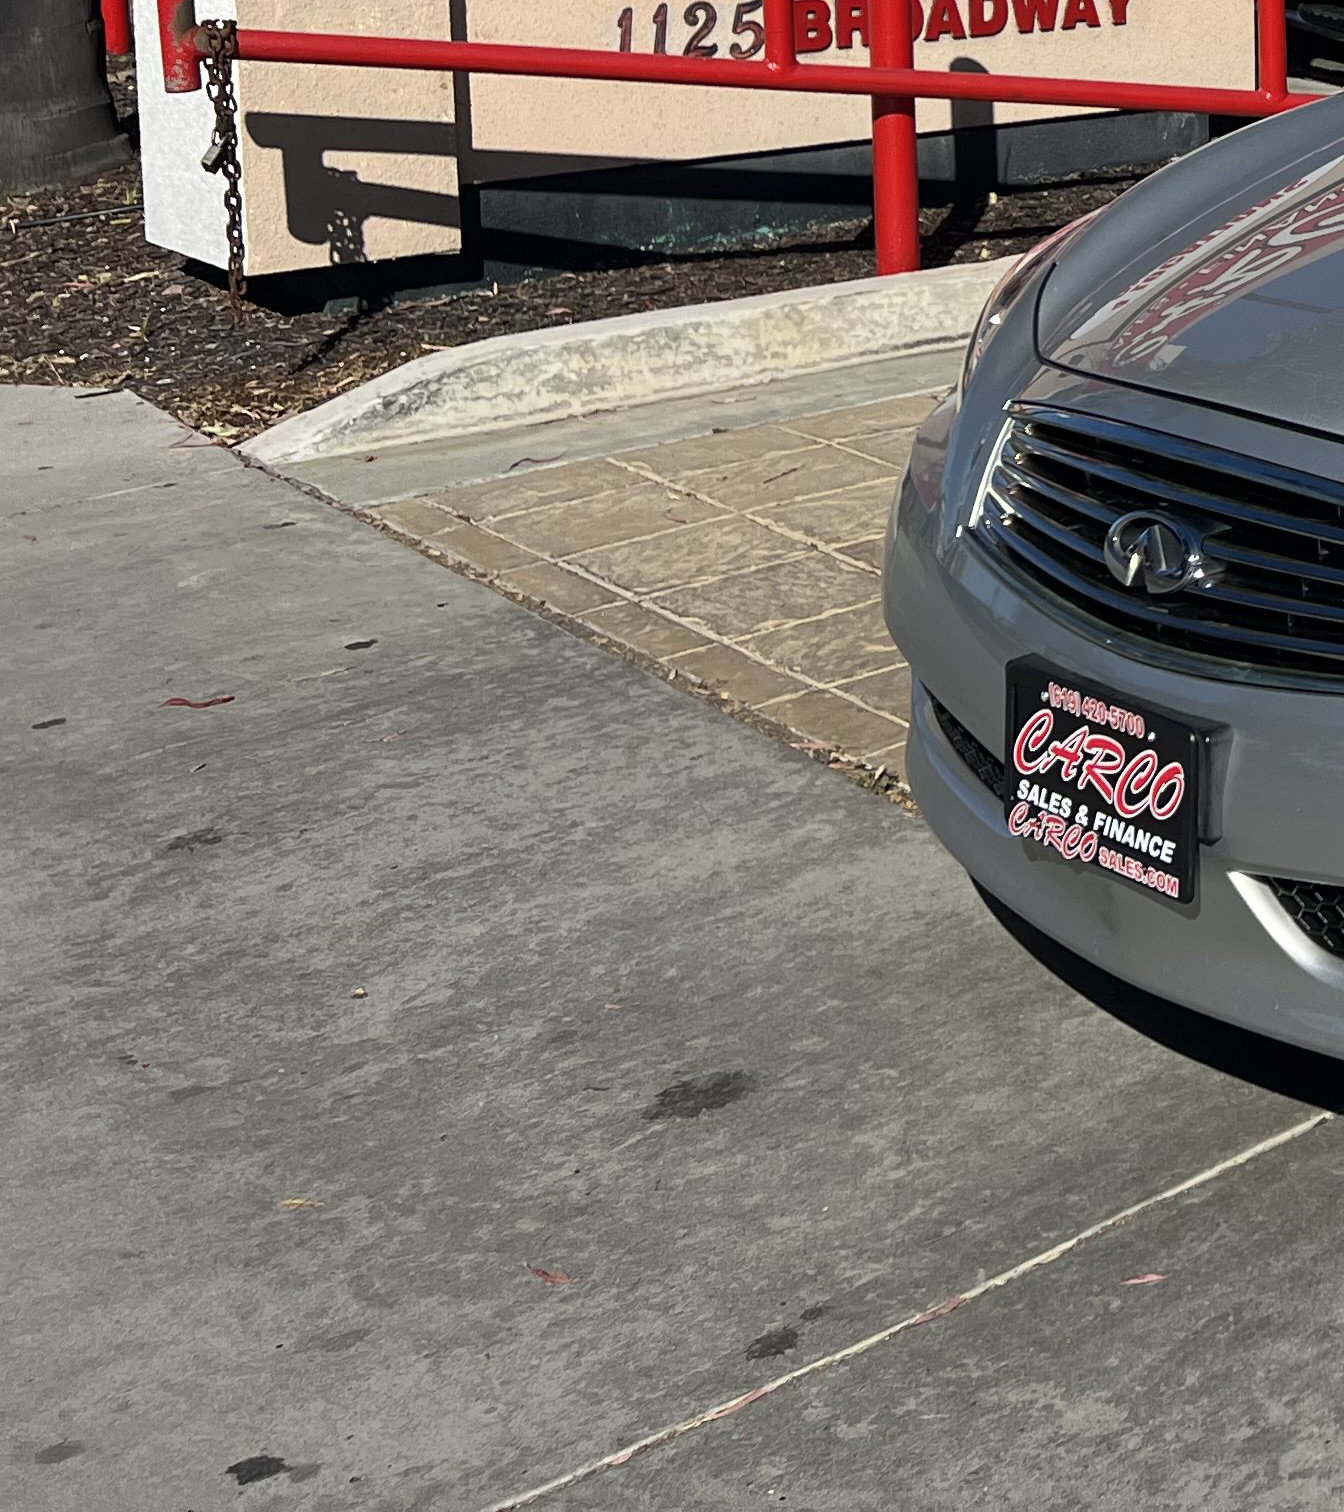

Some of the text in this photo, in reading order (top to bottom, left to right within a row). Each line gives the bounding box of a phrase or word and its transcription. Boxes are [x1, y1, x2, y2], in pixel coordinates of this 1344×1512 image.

[1013, 709, 1185, 820] CARCO
[1008, 801, 1098, 863] CARCO
[1017, 779, 1177, 864] SALES & FINANCE
